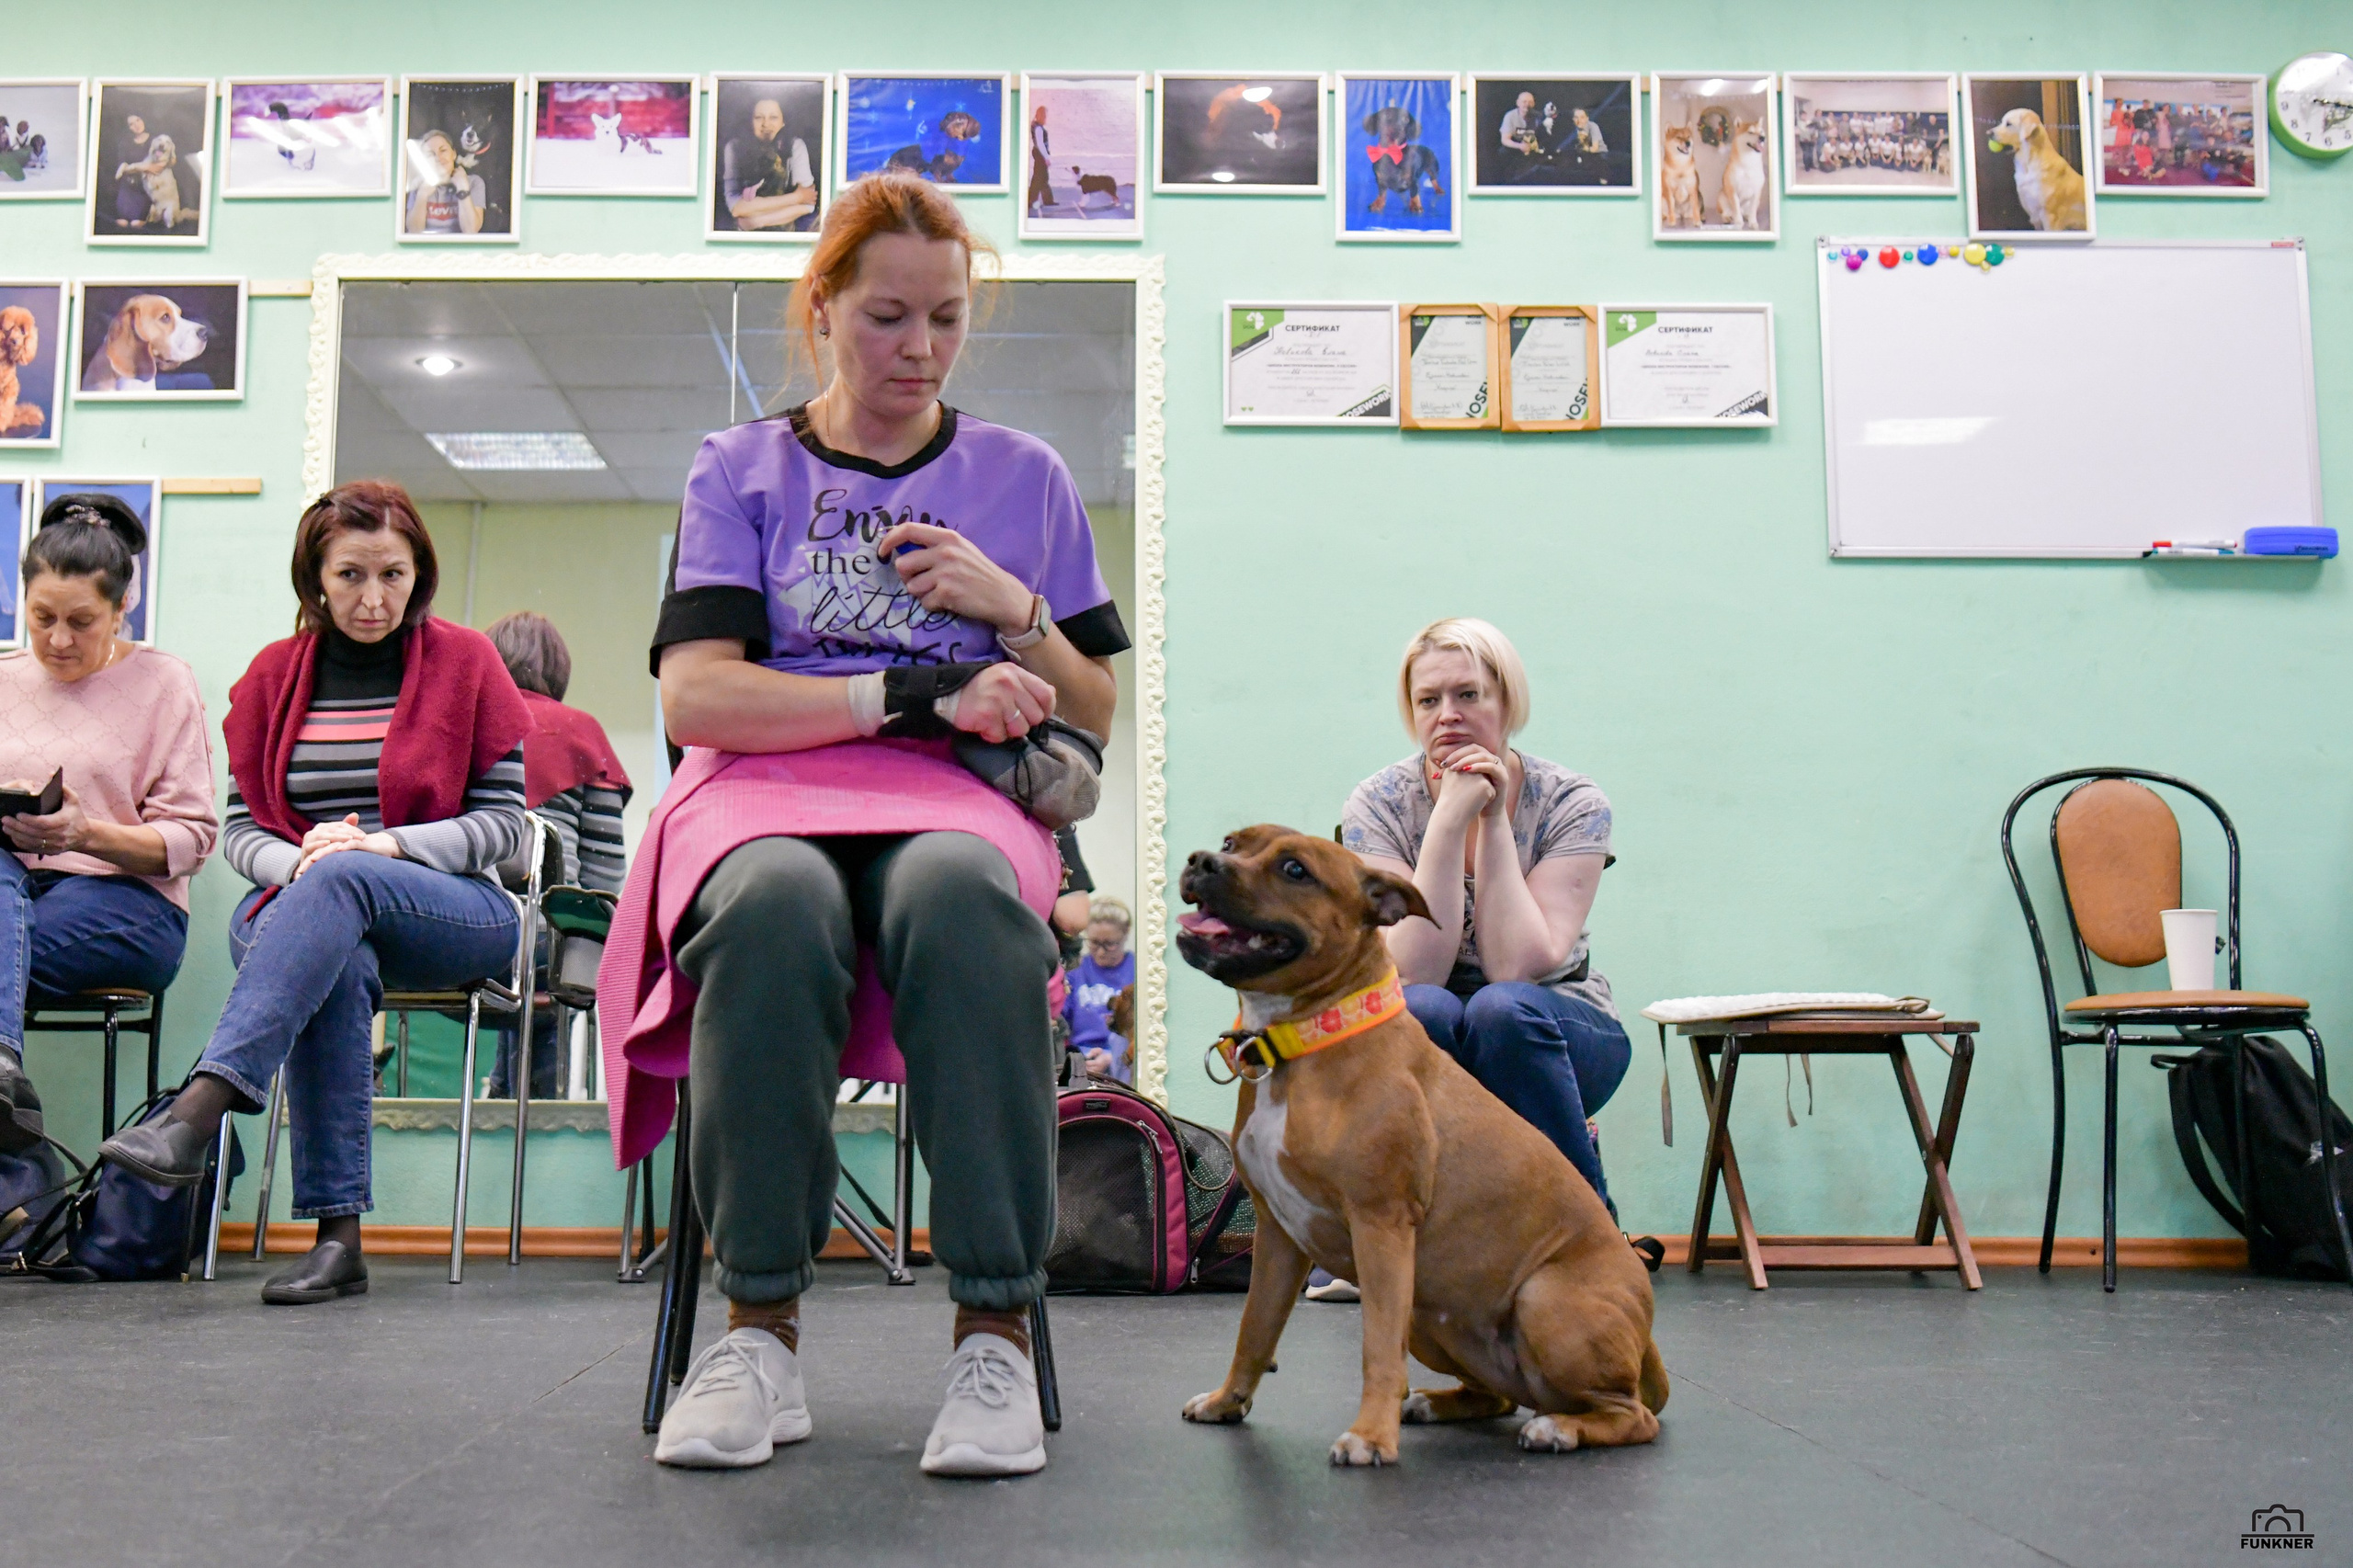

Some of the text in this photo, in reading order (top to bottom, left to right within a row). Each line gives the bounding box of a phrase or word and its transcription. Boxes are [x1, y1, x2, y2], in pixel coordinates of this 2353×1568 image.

[1342, 391, 1391, 417] OSEWORK
[1718, 391, 1768, 417] OSEWORK
[811, 548, 871, 575] the
